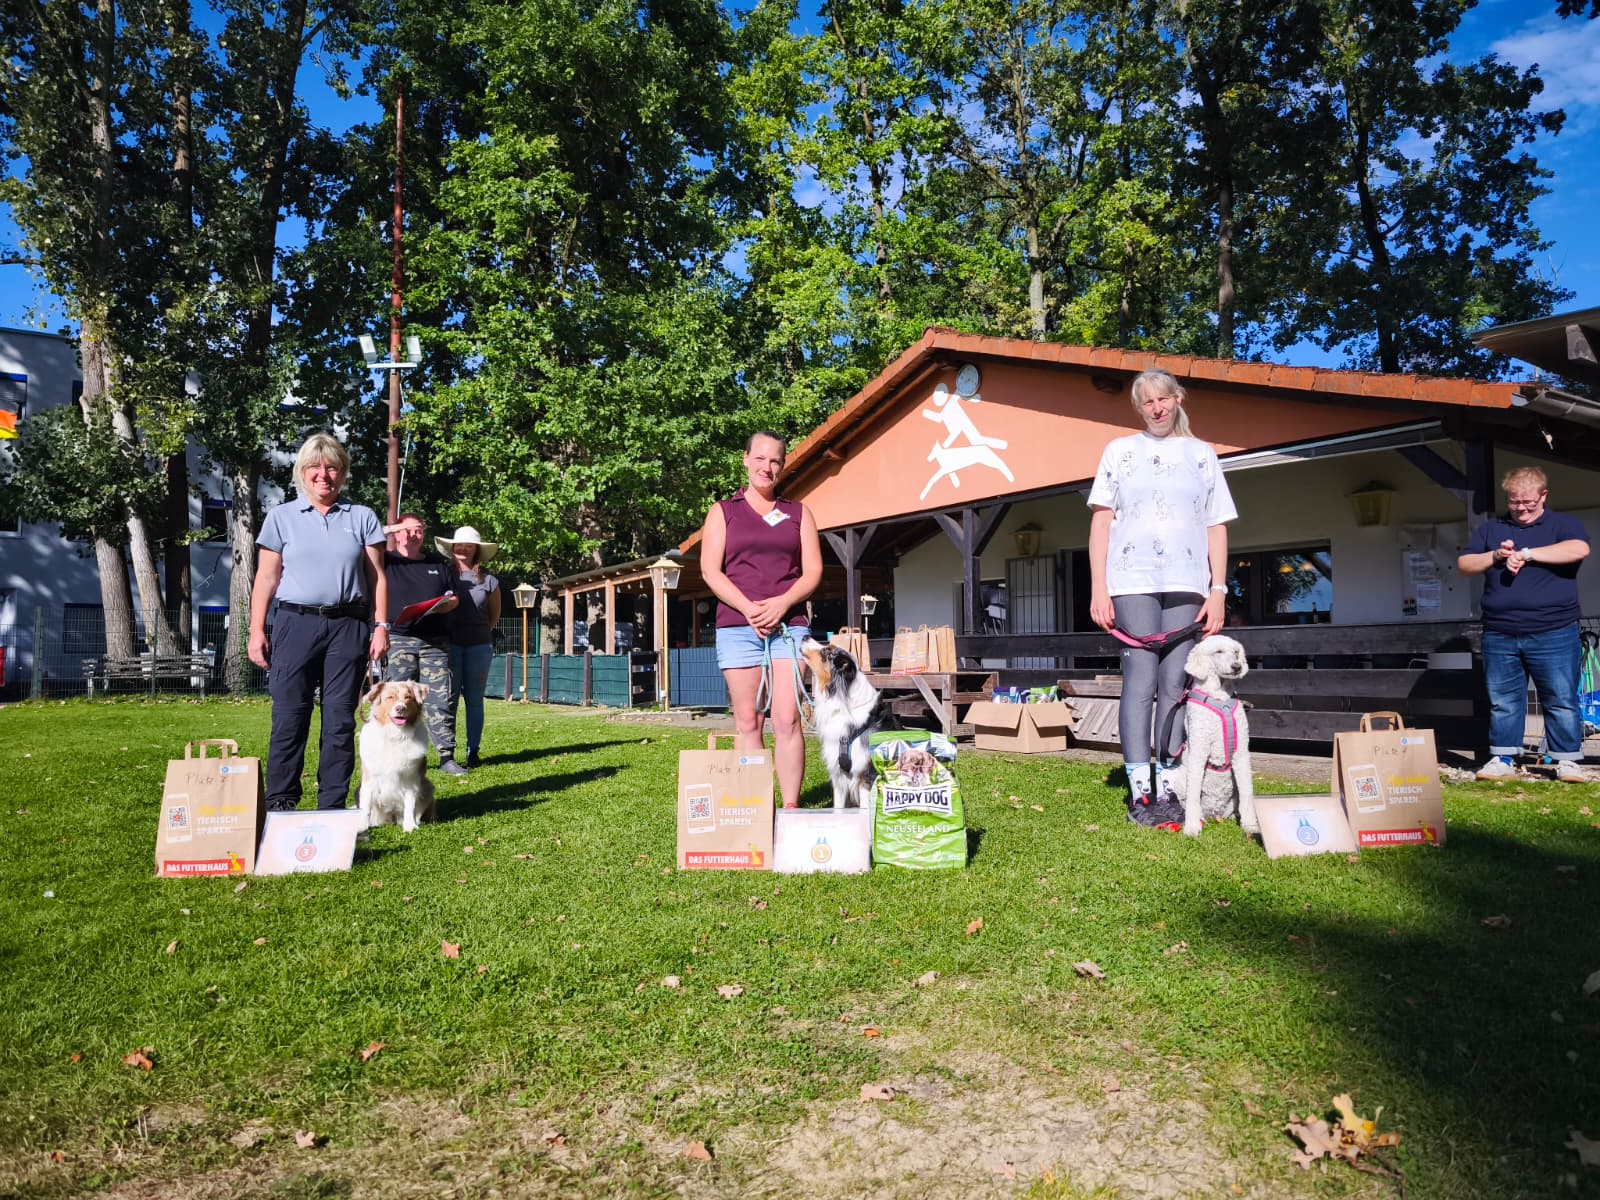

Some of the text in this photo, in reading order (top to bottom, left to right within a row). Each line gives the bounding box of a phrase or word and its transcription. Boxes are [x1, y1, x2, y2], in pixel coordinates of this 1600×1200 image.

[886, 789, 949, 807] HAPPY DOG
[720, 807, 757, 816] TIERISCH
[886, 824, 950, 833] NEUSEELAND
[1361, 831, 1422, 842] DAS FUTTERHAUS
[688, 855, 749, 864] DAS FUTTERHAUS
[166, 862, 229, 872] DAS FUTTERHAUS
